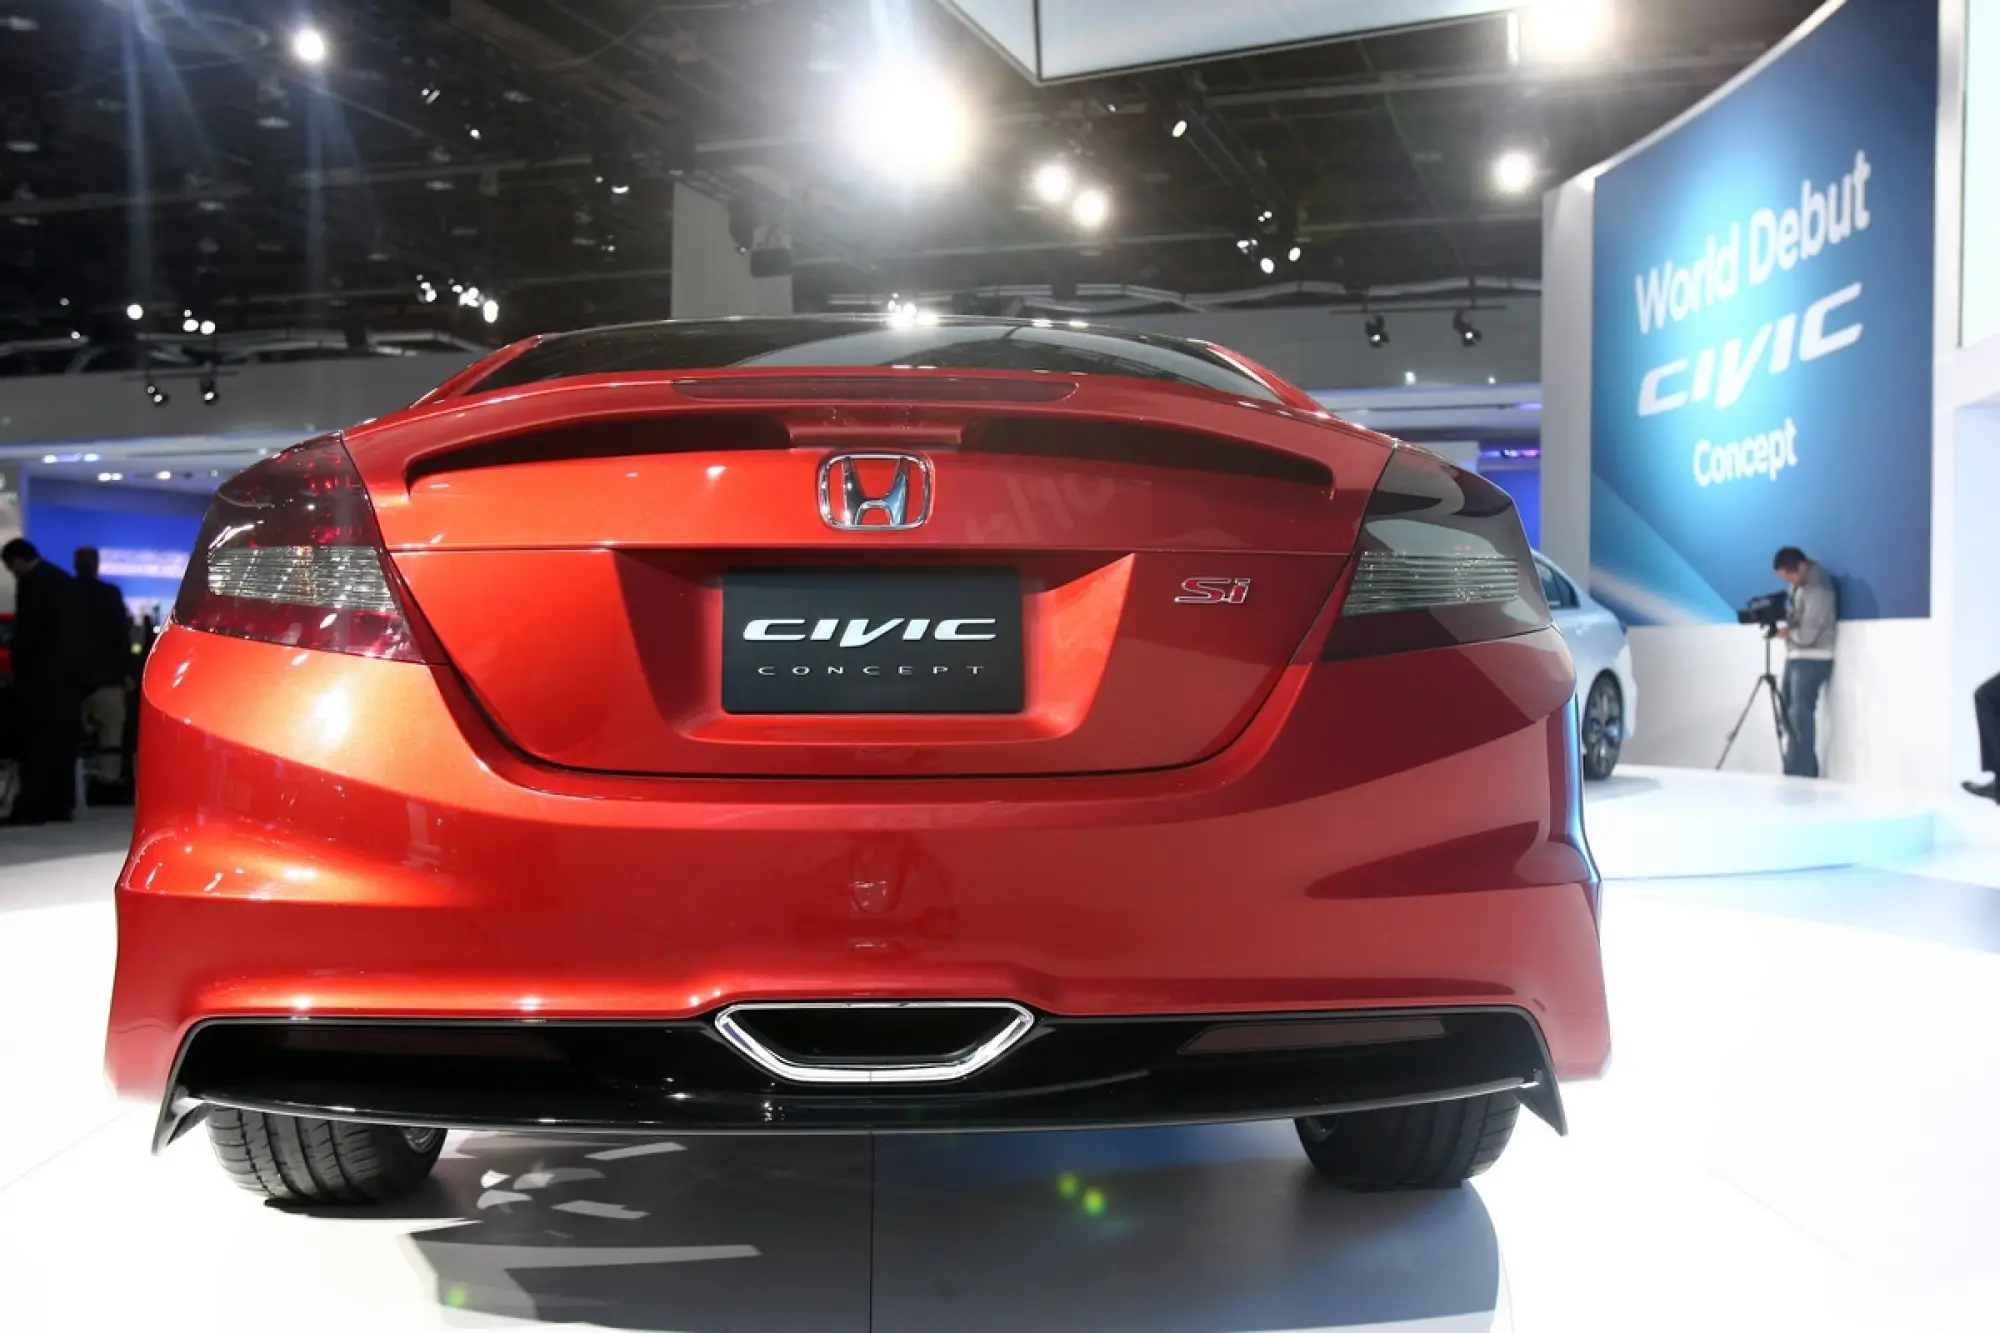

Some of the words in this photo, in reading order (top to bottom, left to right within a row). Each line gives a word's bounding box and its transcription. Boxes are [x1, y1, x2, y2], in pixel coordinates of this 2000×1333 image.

[1635, 221, 1740, 335] World
[1749, 149, 1871, 286] Debut
[1637, 281, 1864, 417] CIVIC
[1692, 416, 1798, 486] Concept
[1174, 577, 1251, 604] Si
[743, 617, 997, 648] CIVIC
[757, 665, 985, 676] CONCEPT
